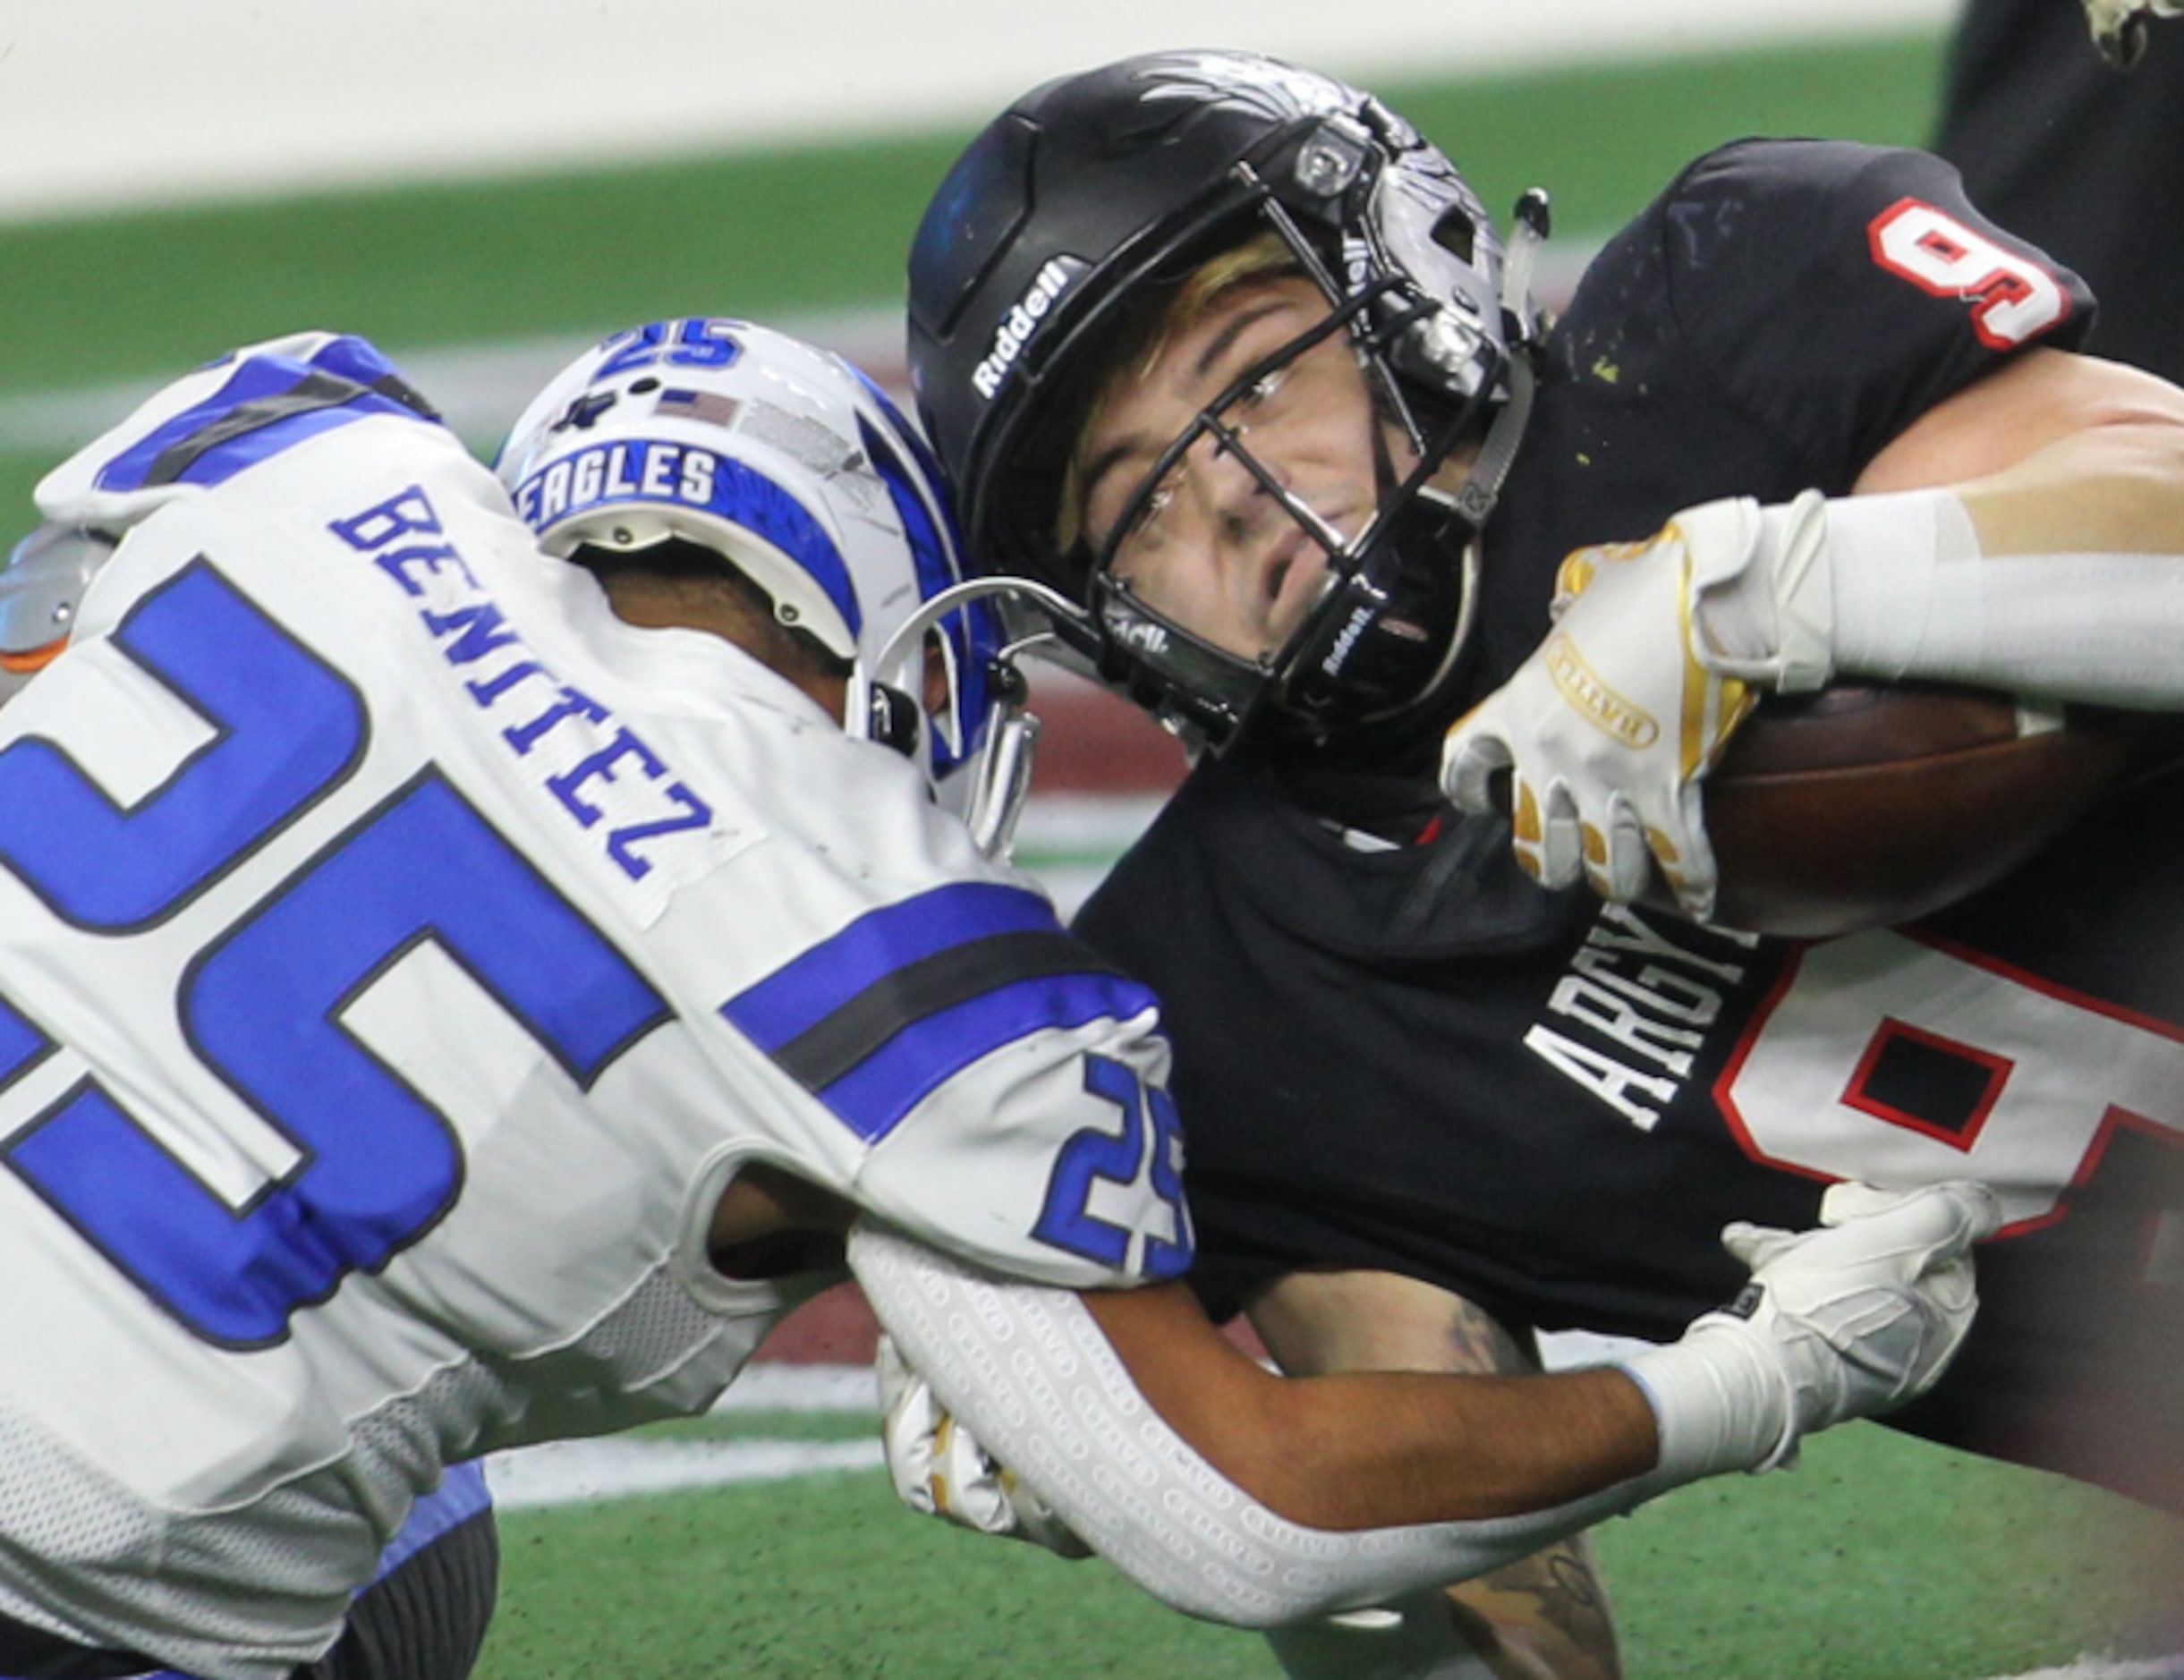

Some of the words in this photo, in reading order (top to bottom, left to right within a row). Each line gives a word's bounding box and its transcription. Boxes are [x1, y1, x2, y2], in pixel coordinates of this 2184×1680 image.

[971, 259, 1069, 400] Riddell
[1866, 197, 2072, 352] 9
[516, 445, 716, 525] EAGLES
[327, 485, 712, 883] BENITEZ
[0, 552, 679, 1353] 25
[1523, 901, 1760, 1133] ARGY
[1027, 1048, 1196, 1278] 25
[1712, 925, 2184, 1285] 9
